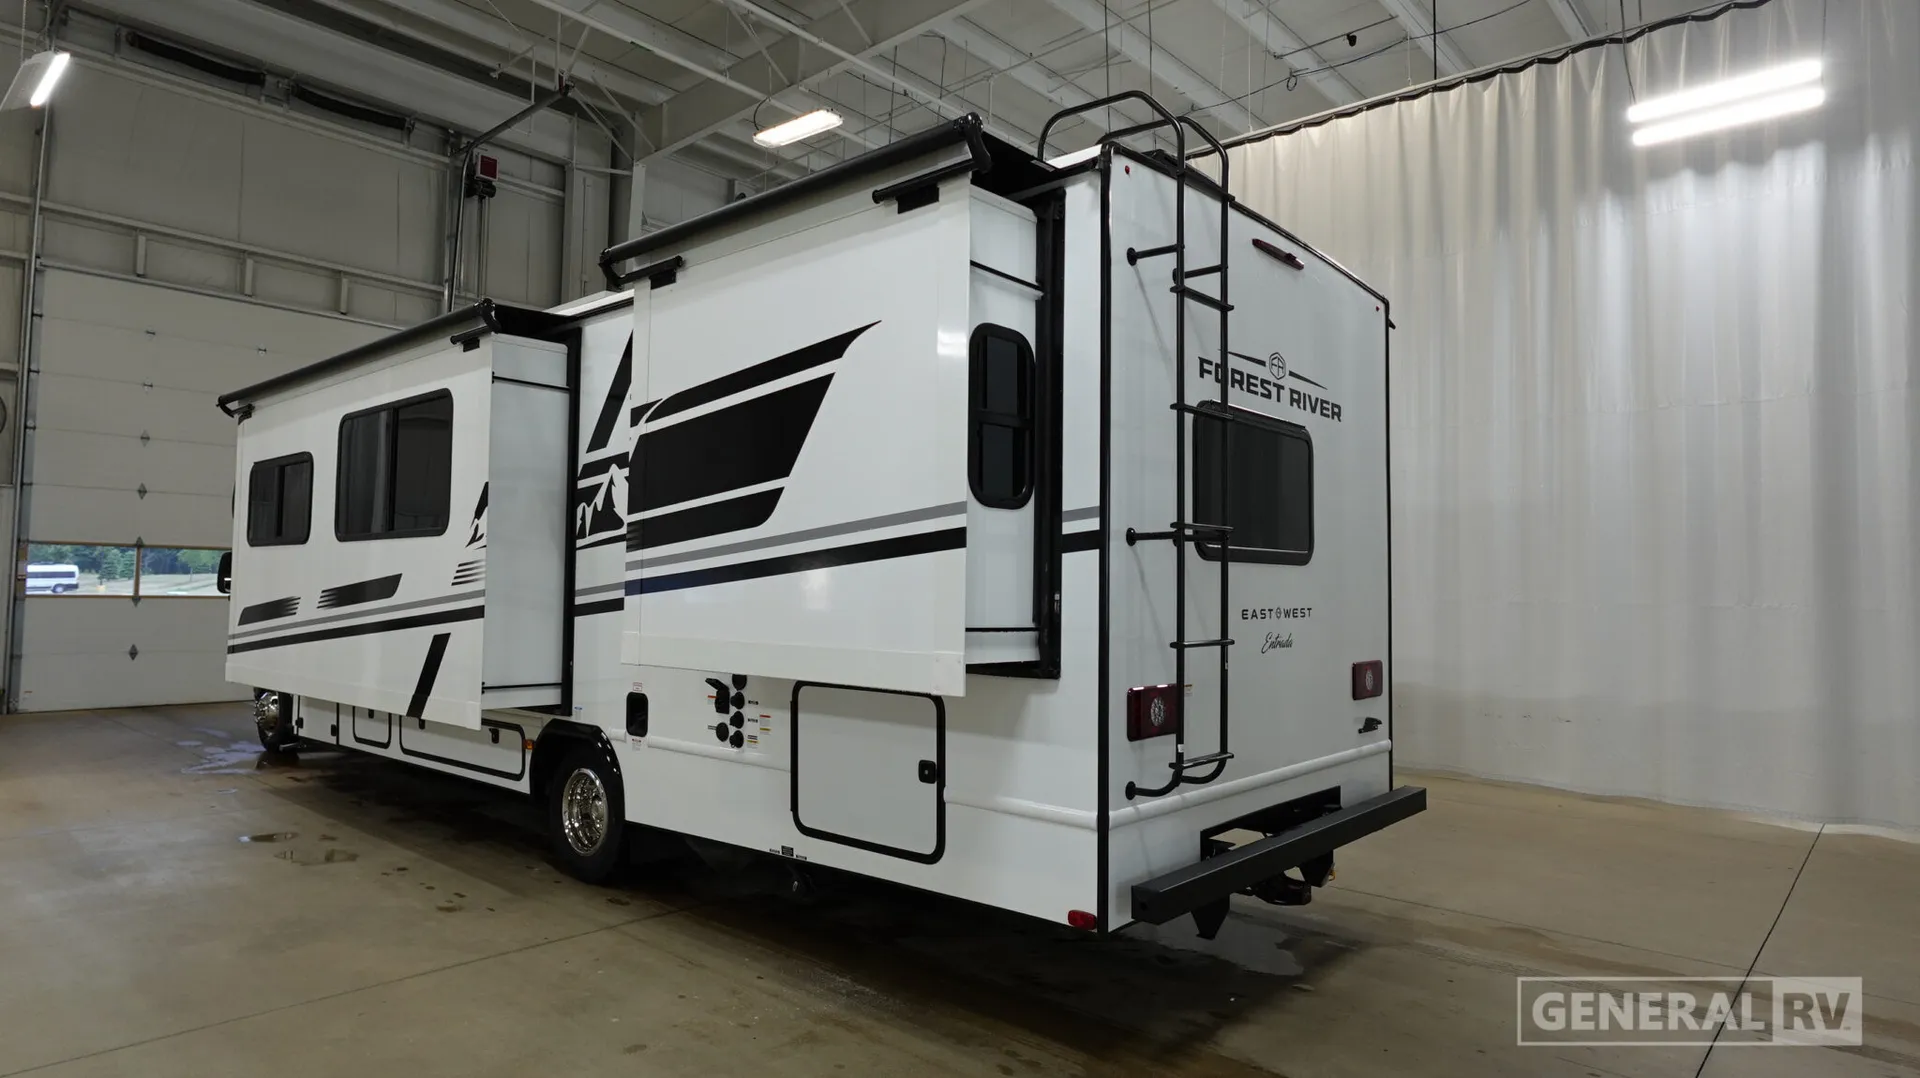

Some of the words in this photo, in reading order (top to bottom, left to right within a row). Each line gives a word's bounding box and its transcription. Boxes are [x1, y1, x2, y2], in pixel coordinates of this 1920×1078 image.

[1289, 387, 1342, 422] RIVER
[1241, 608, 1274, 620] EAST
[1283, 607, 1312, 619] WEST
